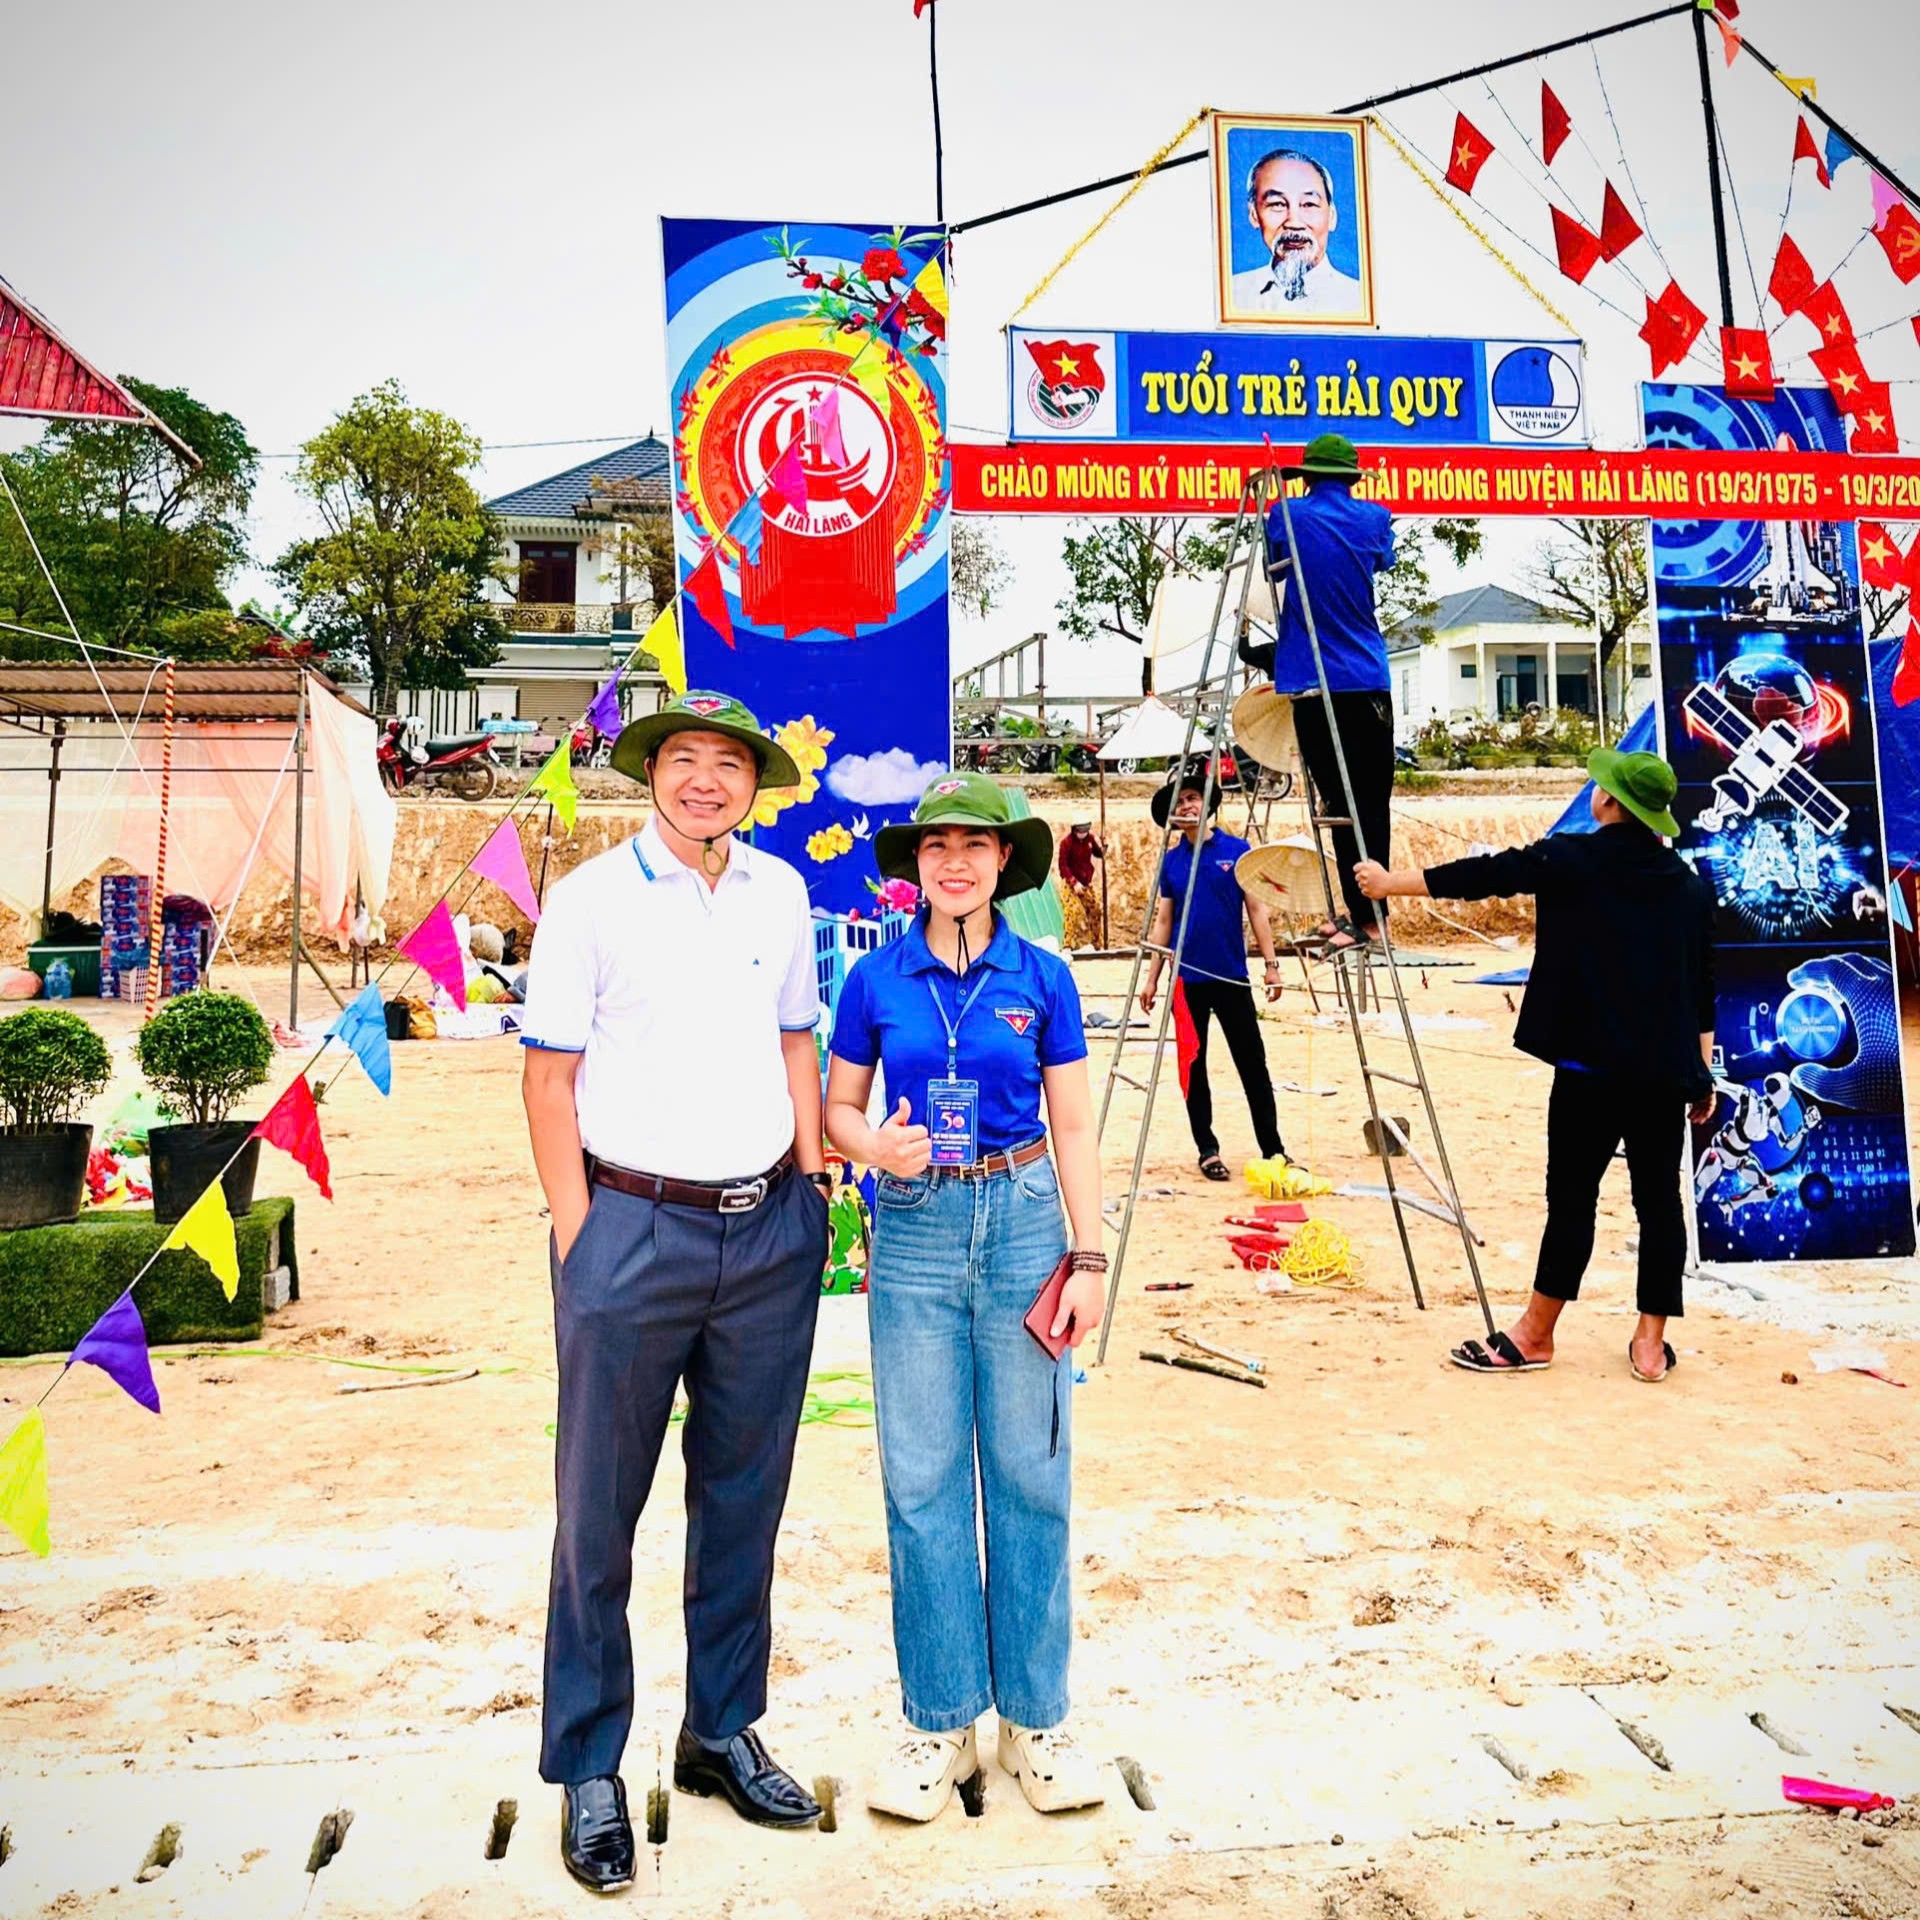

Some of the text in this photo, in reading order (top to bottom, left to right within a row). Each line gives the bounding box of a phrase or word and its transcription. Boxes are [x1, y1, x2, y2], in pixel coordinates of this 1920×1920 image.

[1141, 350, 1229, 414] TUỔI
[1237, 358, 1307, 416] TRẺ
[1315, 359, 1381, 416] HẢI
[1389, 376, 1463, 426] QUY
[1510, 410, 1541, 420] THANH
[1540, 421, 1560, 430] NAM
[981, 458, 1048, 498] CHÀO
[1056, 458, 1130, 499] MỪNG
[1138, 455, 1169, 499] KỶ
[1177, 459, 1241, 507] NIỆM
[1351, 456, 1399, 500] GIẢI
[1406, 461, 1488, 501] PHÓNG
[1496, 463, 1574, 509] HUYỆN
[1581, 459, 1621, 502] HẢI
[1628, 463, 1689, 502] LĂNG
[1696, 471, 1817, 507] (19/3/1975
[813, 512, 853, 534] LĂNG
[1741, 822, 1819, 889] AI
[941, 1110, 965, 1131] 50
